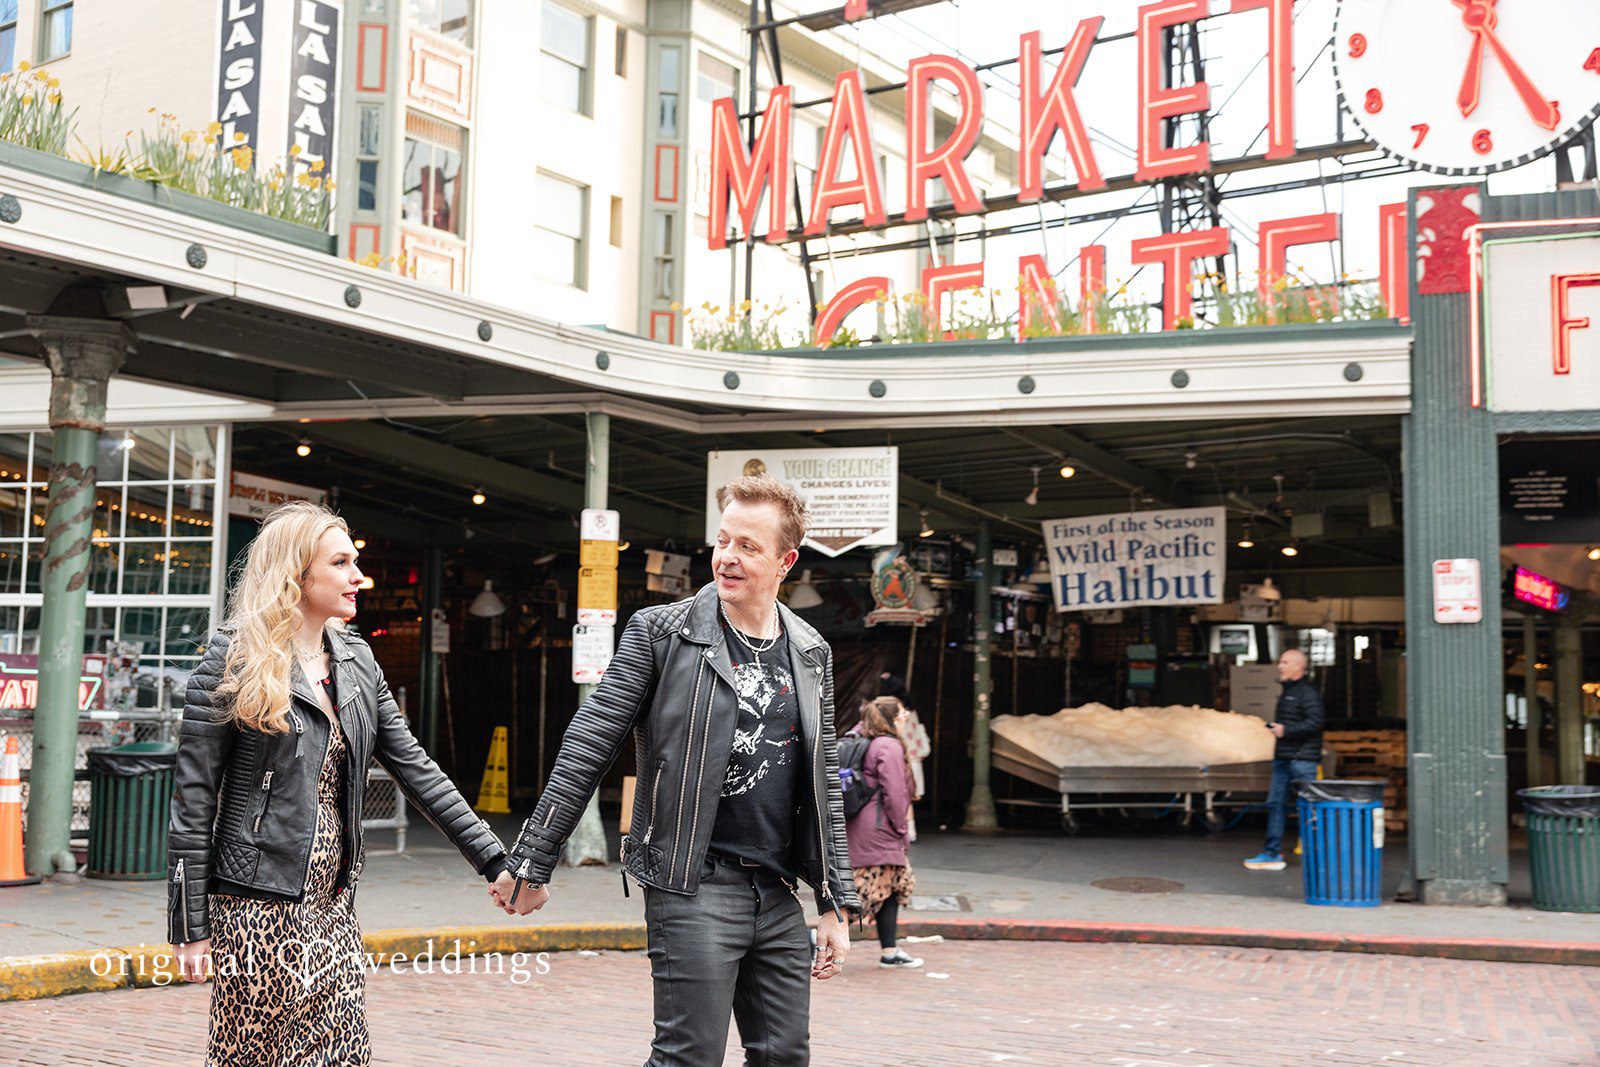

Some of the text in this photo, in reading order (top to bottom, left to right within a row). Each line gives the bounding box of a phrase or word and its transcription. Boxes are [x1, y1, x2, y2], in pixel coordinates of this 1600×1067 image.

[1348, 32, 1368, 59] 9
[1364, 88, 1383, 114] 8
[709, 0, 1297, 250] MARKET
[1410, 123, 1430, 149] 7
[1472, 129, 1493, 156] 6
[783, 458, 891, 479] YOUR CHANGE
[800, 481, 853, 489] CHANGES
[1053, 515, 1215, 539] First of the Season
[1054, 533, 1216, 565] Wild Pacific
[1058, 564, 1217, 607] Halibut
